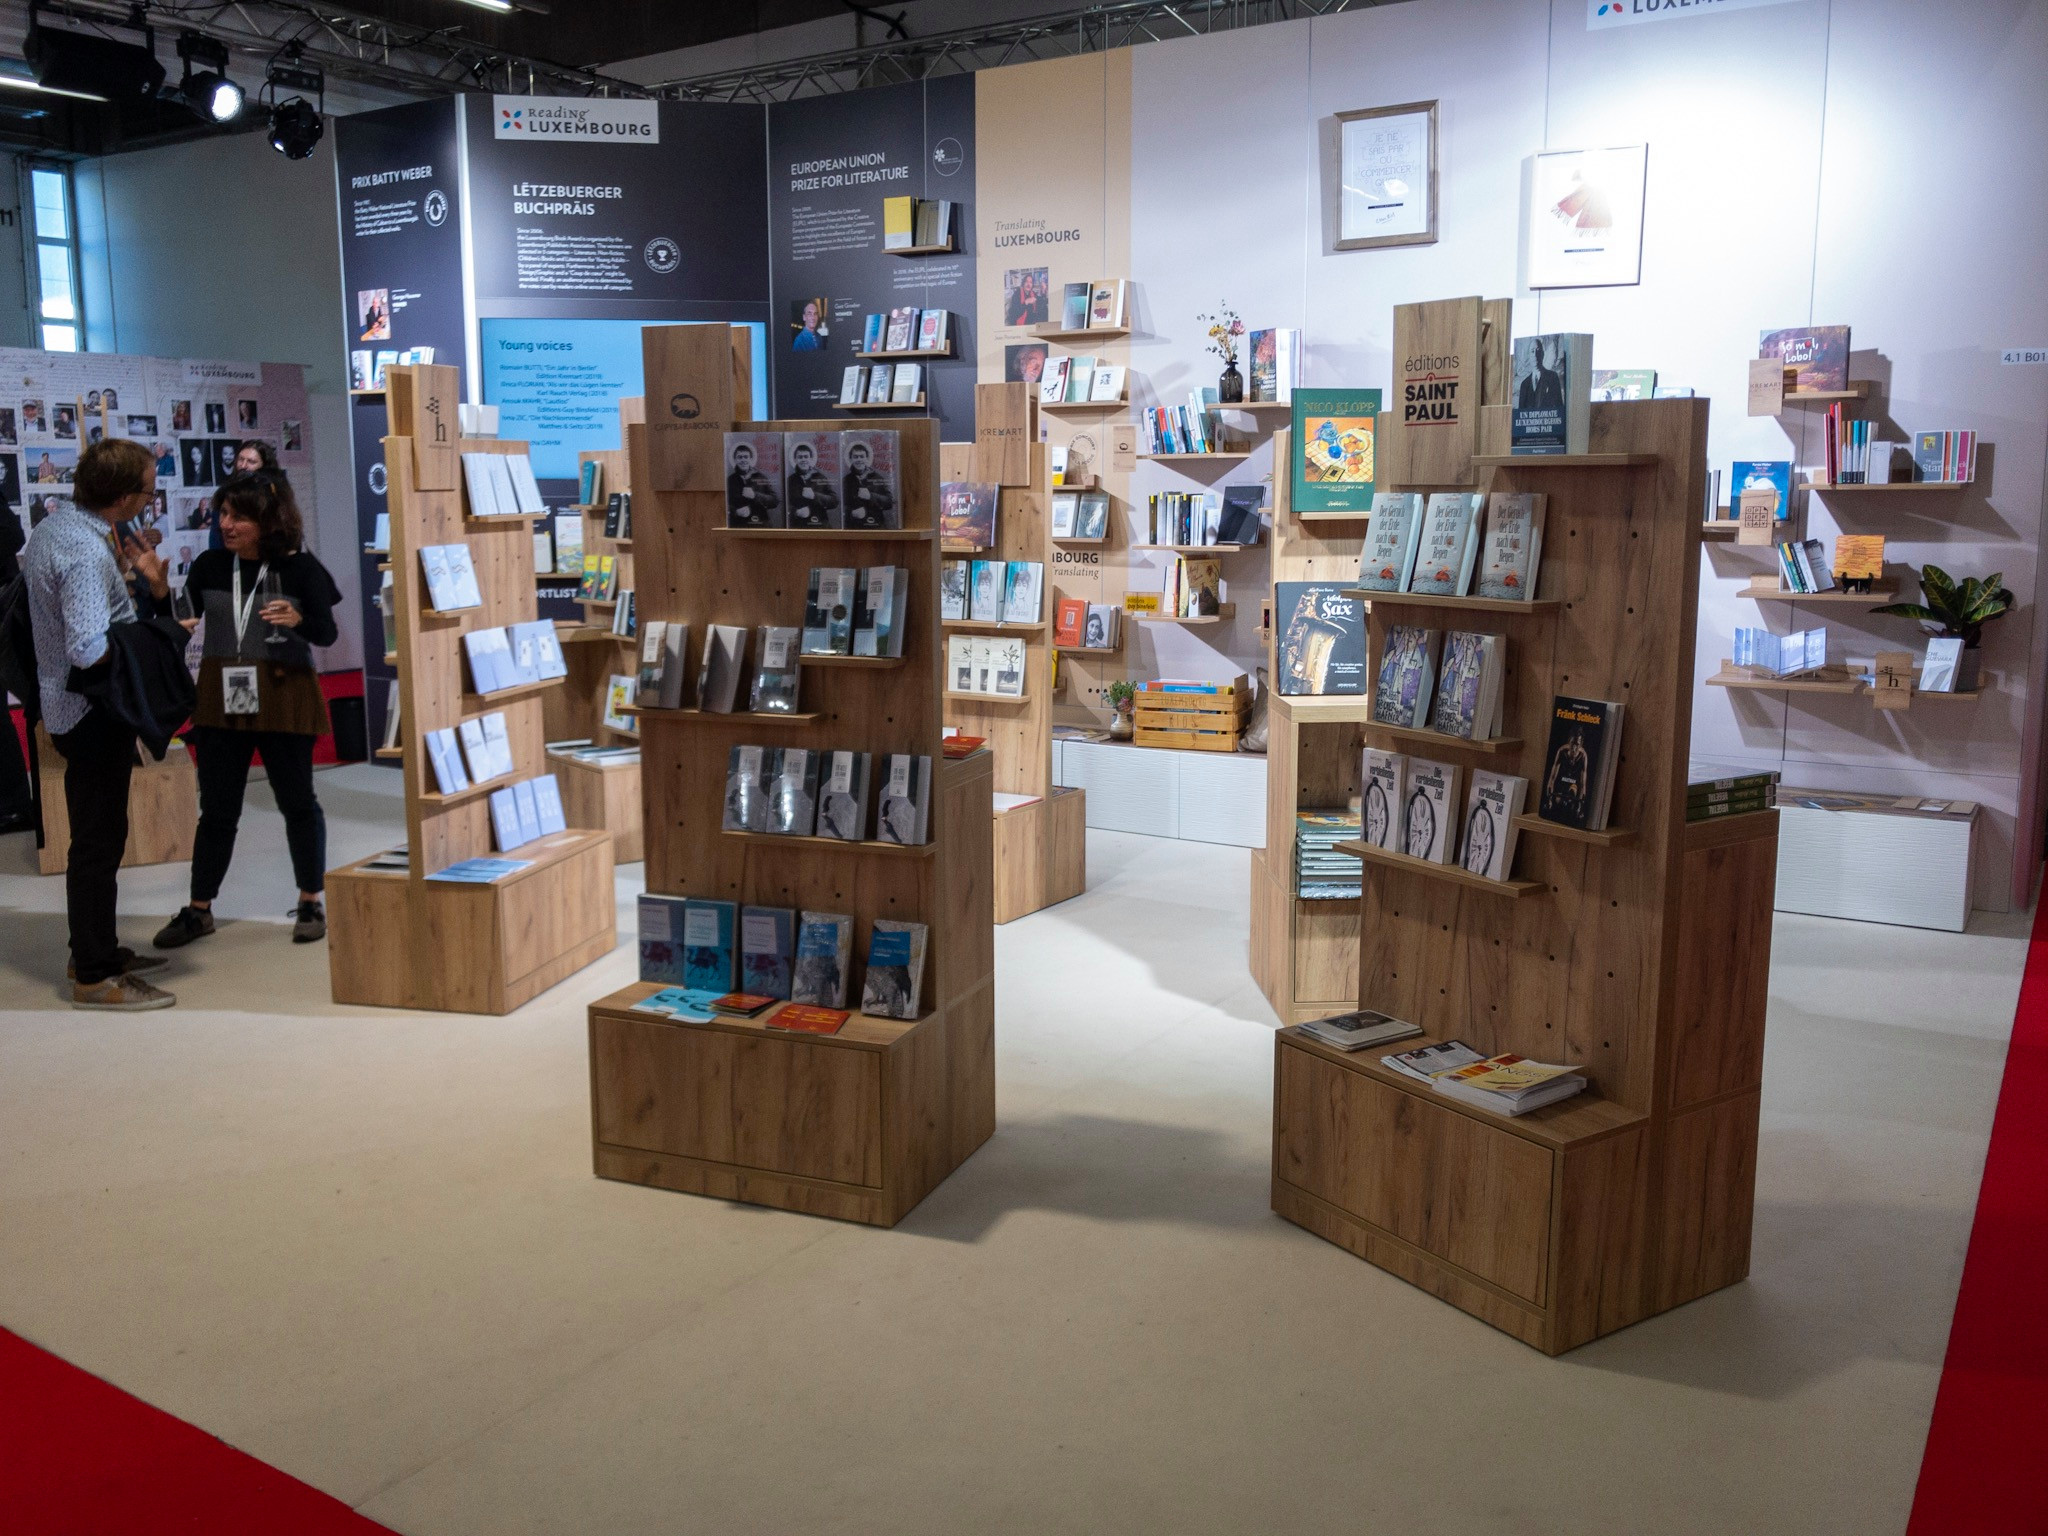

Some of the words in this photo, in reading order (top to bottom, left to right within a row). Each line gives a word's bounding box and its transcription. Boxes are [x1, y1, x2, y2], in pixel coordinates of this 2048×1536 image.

[528, 106, 590, 122] Reading
[530, 121, 651, 136] LUXEMBOURG
[791, 157, 847, 175] EUROPEAN
[849, 152, 885, 168] UNION
[352, 174, 371, 189] PRIX
[372, 170, 400, 186] BATTY
[401, 165, 433, 181] WEBER
[791, 177, 820, 191] PRIZE
[821, 174, 843, 188] FOR
[845, 166, 909, 185] LITERATURE
[514, 200, 595, 215] BUCHPRÄIS
[994, 218, 1046, 231] Translating
[995, 229, 1080, 247] LUXEMBOURG
[498, 340, 533, 352] Young
[536, 341, 573, 351] voices
[1405, 353, 1460, 372] éditions
[1785, 350, 1813, 363] Lobo!
[2004, 353, 2021, 363] 4.1
[1405, 382, 1459, 401] SAINT
[1303, 402, 1333, 413] NICO
[1335, 402, 1375, 413] KLOPP
[1405, 399, 1458, 421] PAUL
[1519, 411, 1528, 419] UN
[1528, 410, 1558, 419] DIPLOMATE
[1525, 426, 1540, 434] HORS
[951, 504, 971, 517] Lobo!
[1321, 602, 1353, 619] Sax
[1576, 709, 1601, 725] Schleck
[1433, 766, 1441, 778] Die
[1386, 779, 1394, 791] Zeit
[1434, 789, 1443, 801] Zeit
[1495, 801, 1504, 814] Zeit
